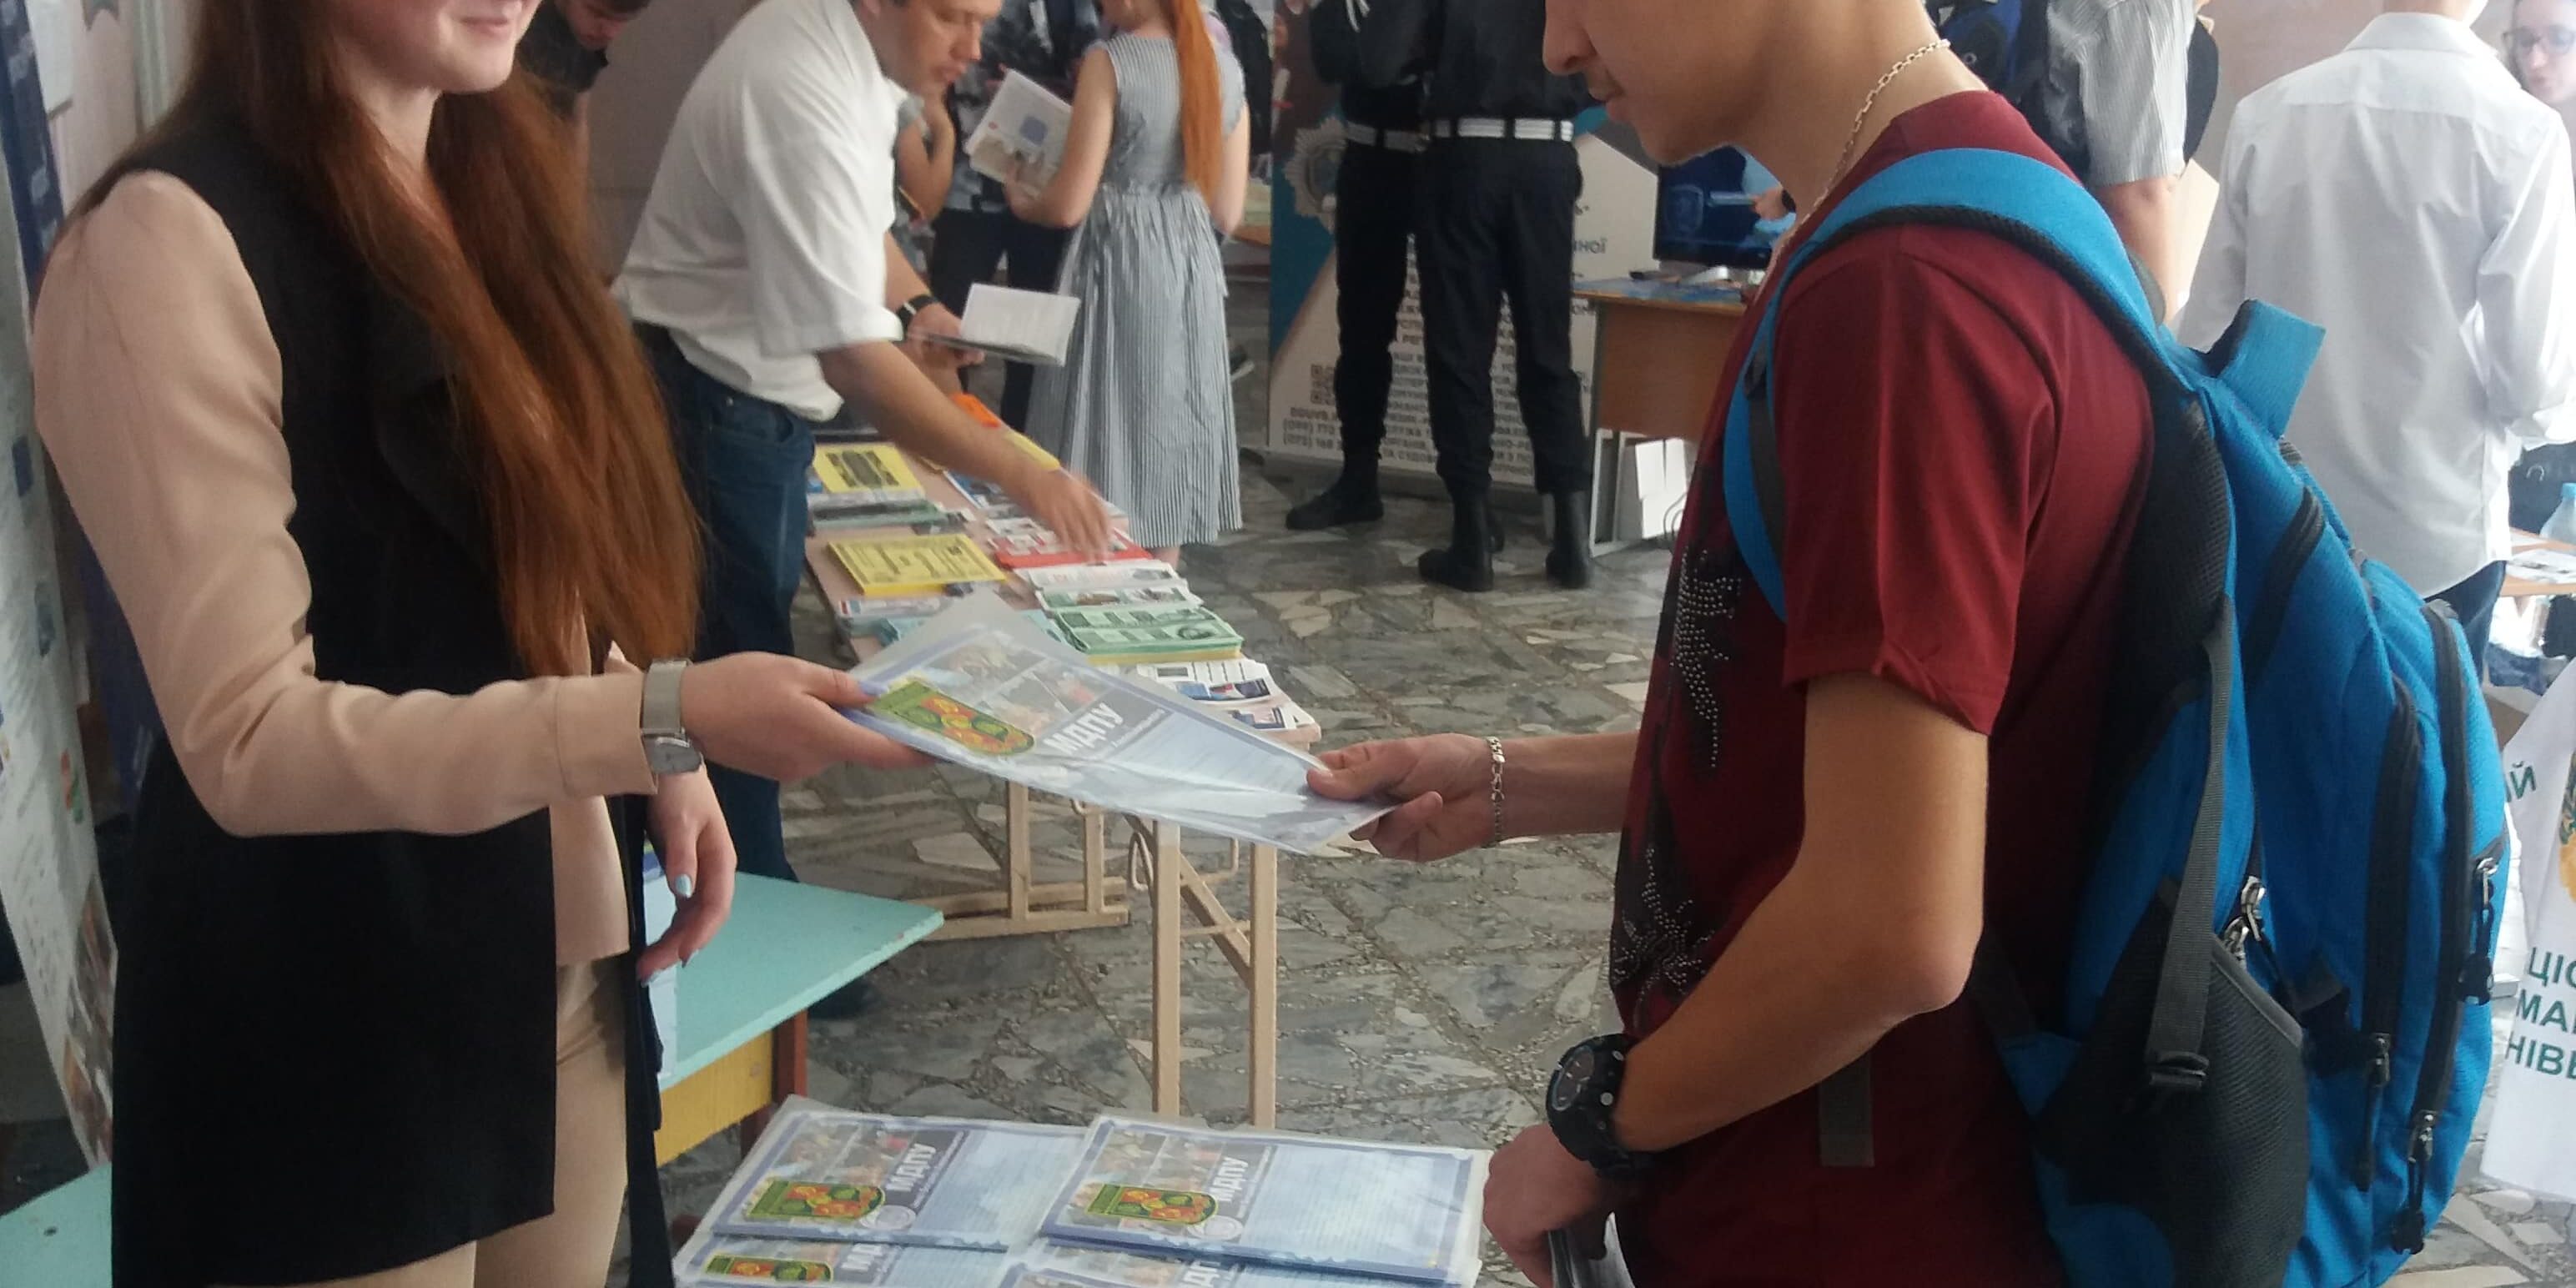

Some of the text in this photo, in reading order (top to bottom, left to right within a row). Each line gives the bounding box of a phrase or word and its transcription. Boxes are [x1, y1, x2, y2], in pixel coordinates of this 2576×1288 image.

[1044, 702, 1124, 755] МДПУ
[2516, 989, 2576, 1035] МА
[885, 1143, 937, 1192] МДПУ
[1214, 1156, 1249, 1203] МДПУ
